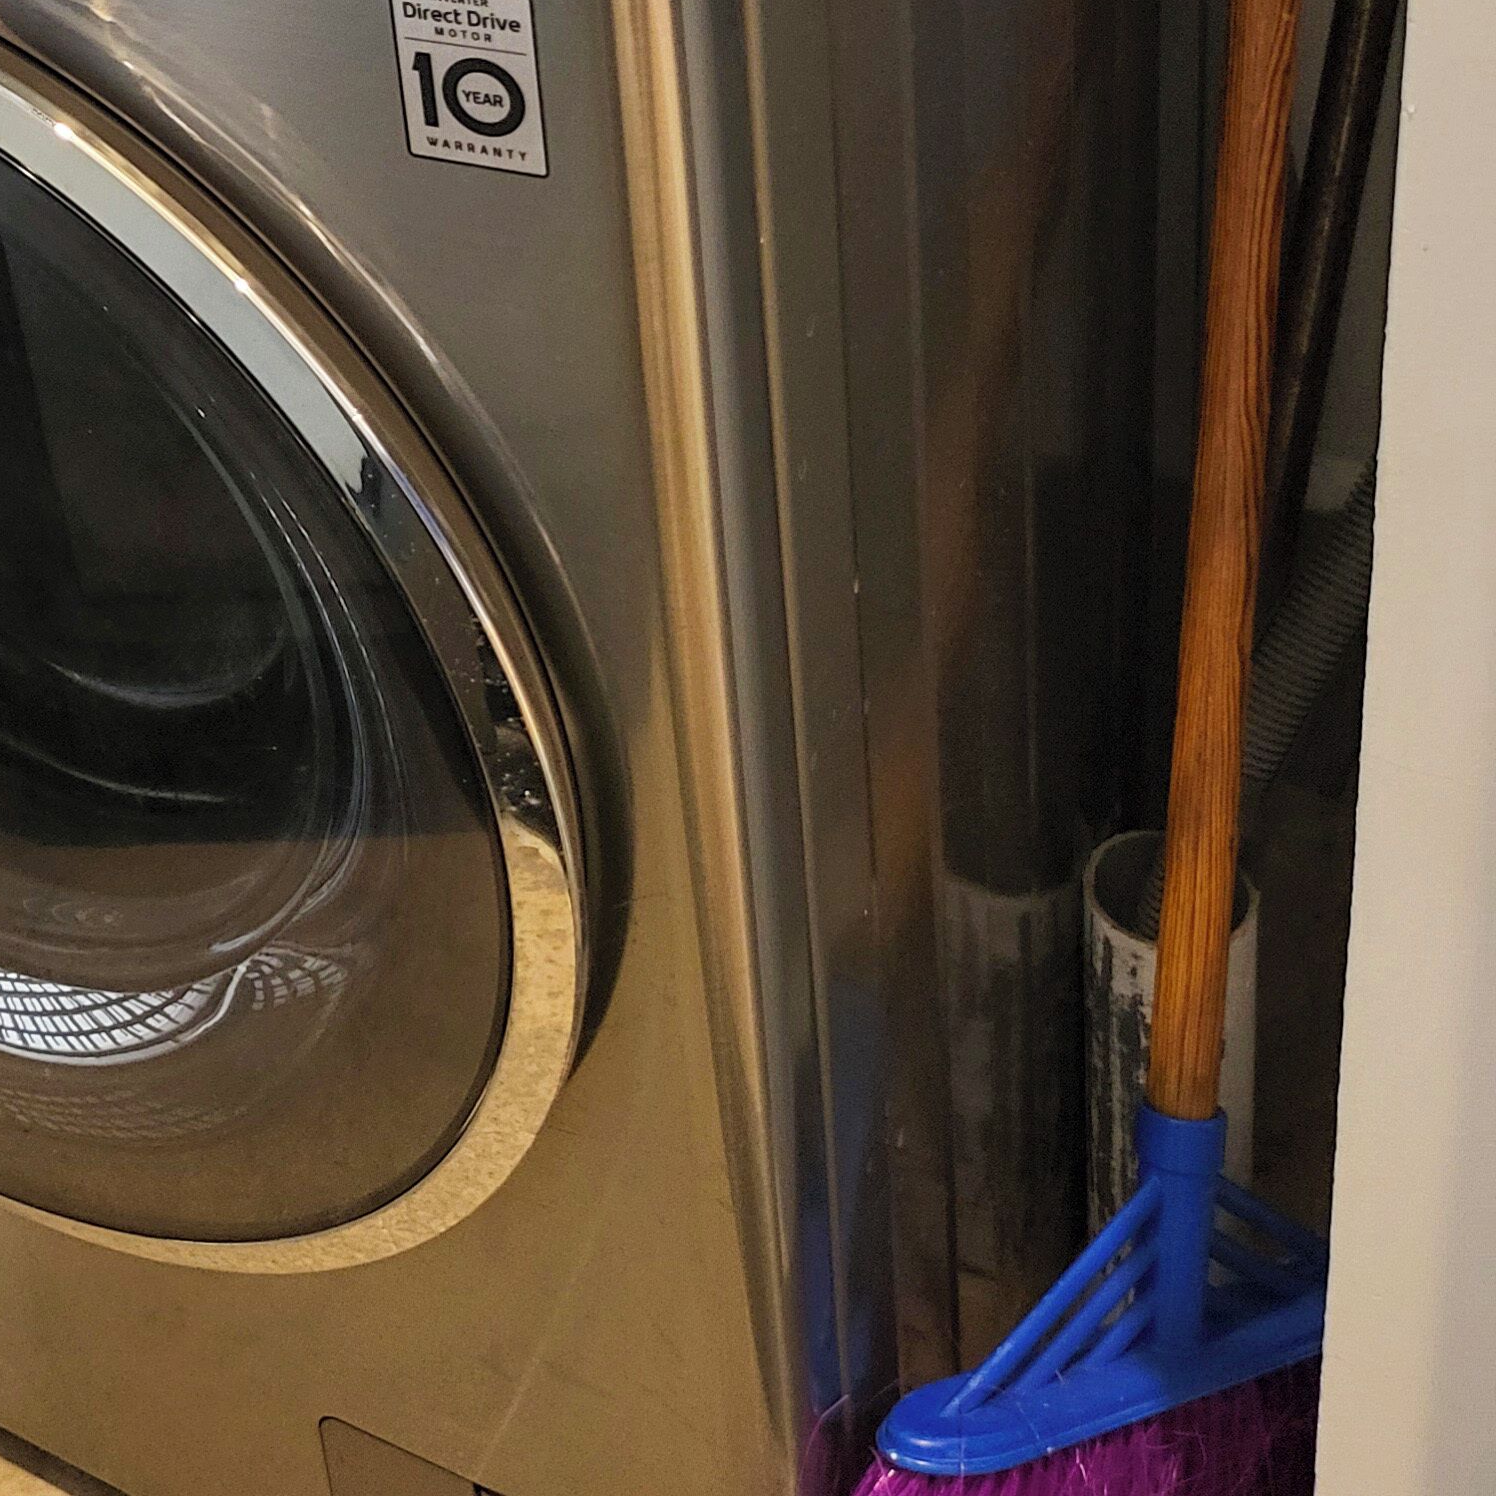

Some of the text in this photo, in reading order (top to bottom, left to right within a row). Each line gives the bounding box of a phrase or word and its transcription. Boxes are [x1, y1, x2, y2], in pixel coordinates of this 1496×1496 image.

[402, 1, 521, 33] Direct Drive
[434, 26, 492, 43] MOTOR
[412, 51, 526, 137] 10
[462, 89, 504, 108] YEAR
[426, 135, 527, 161] WARRANTY
